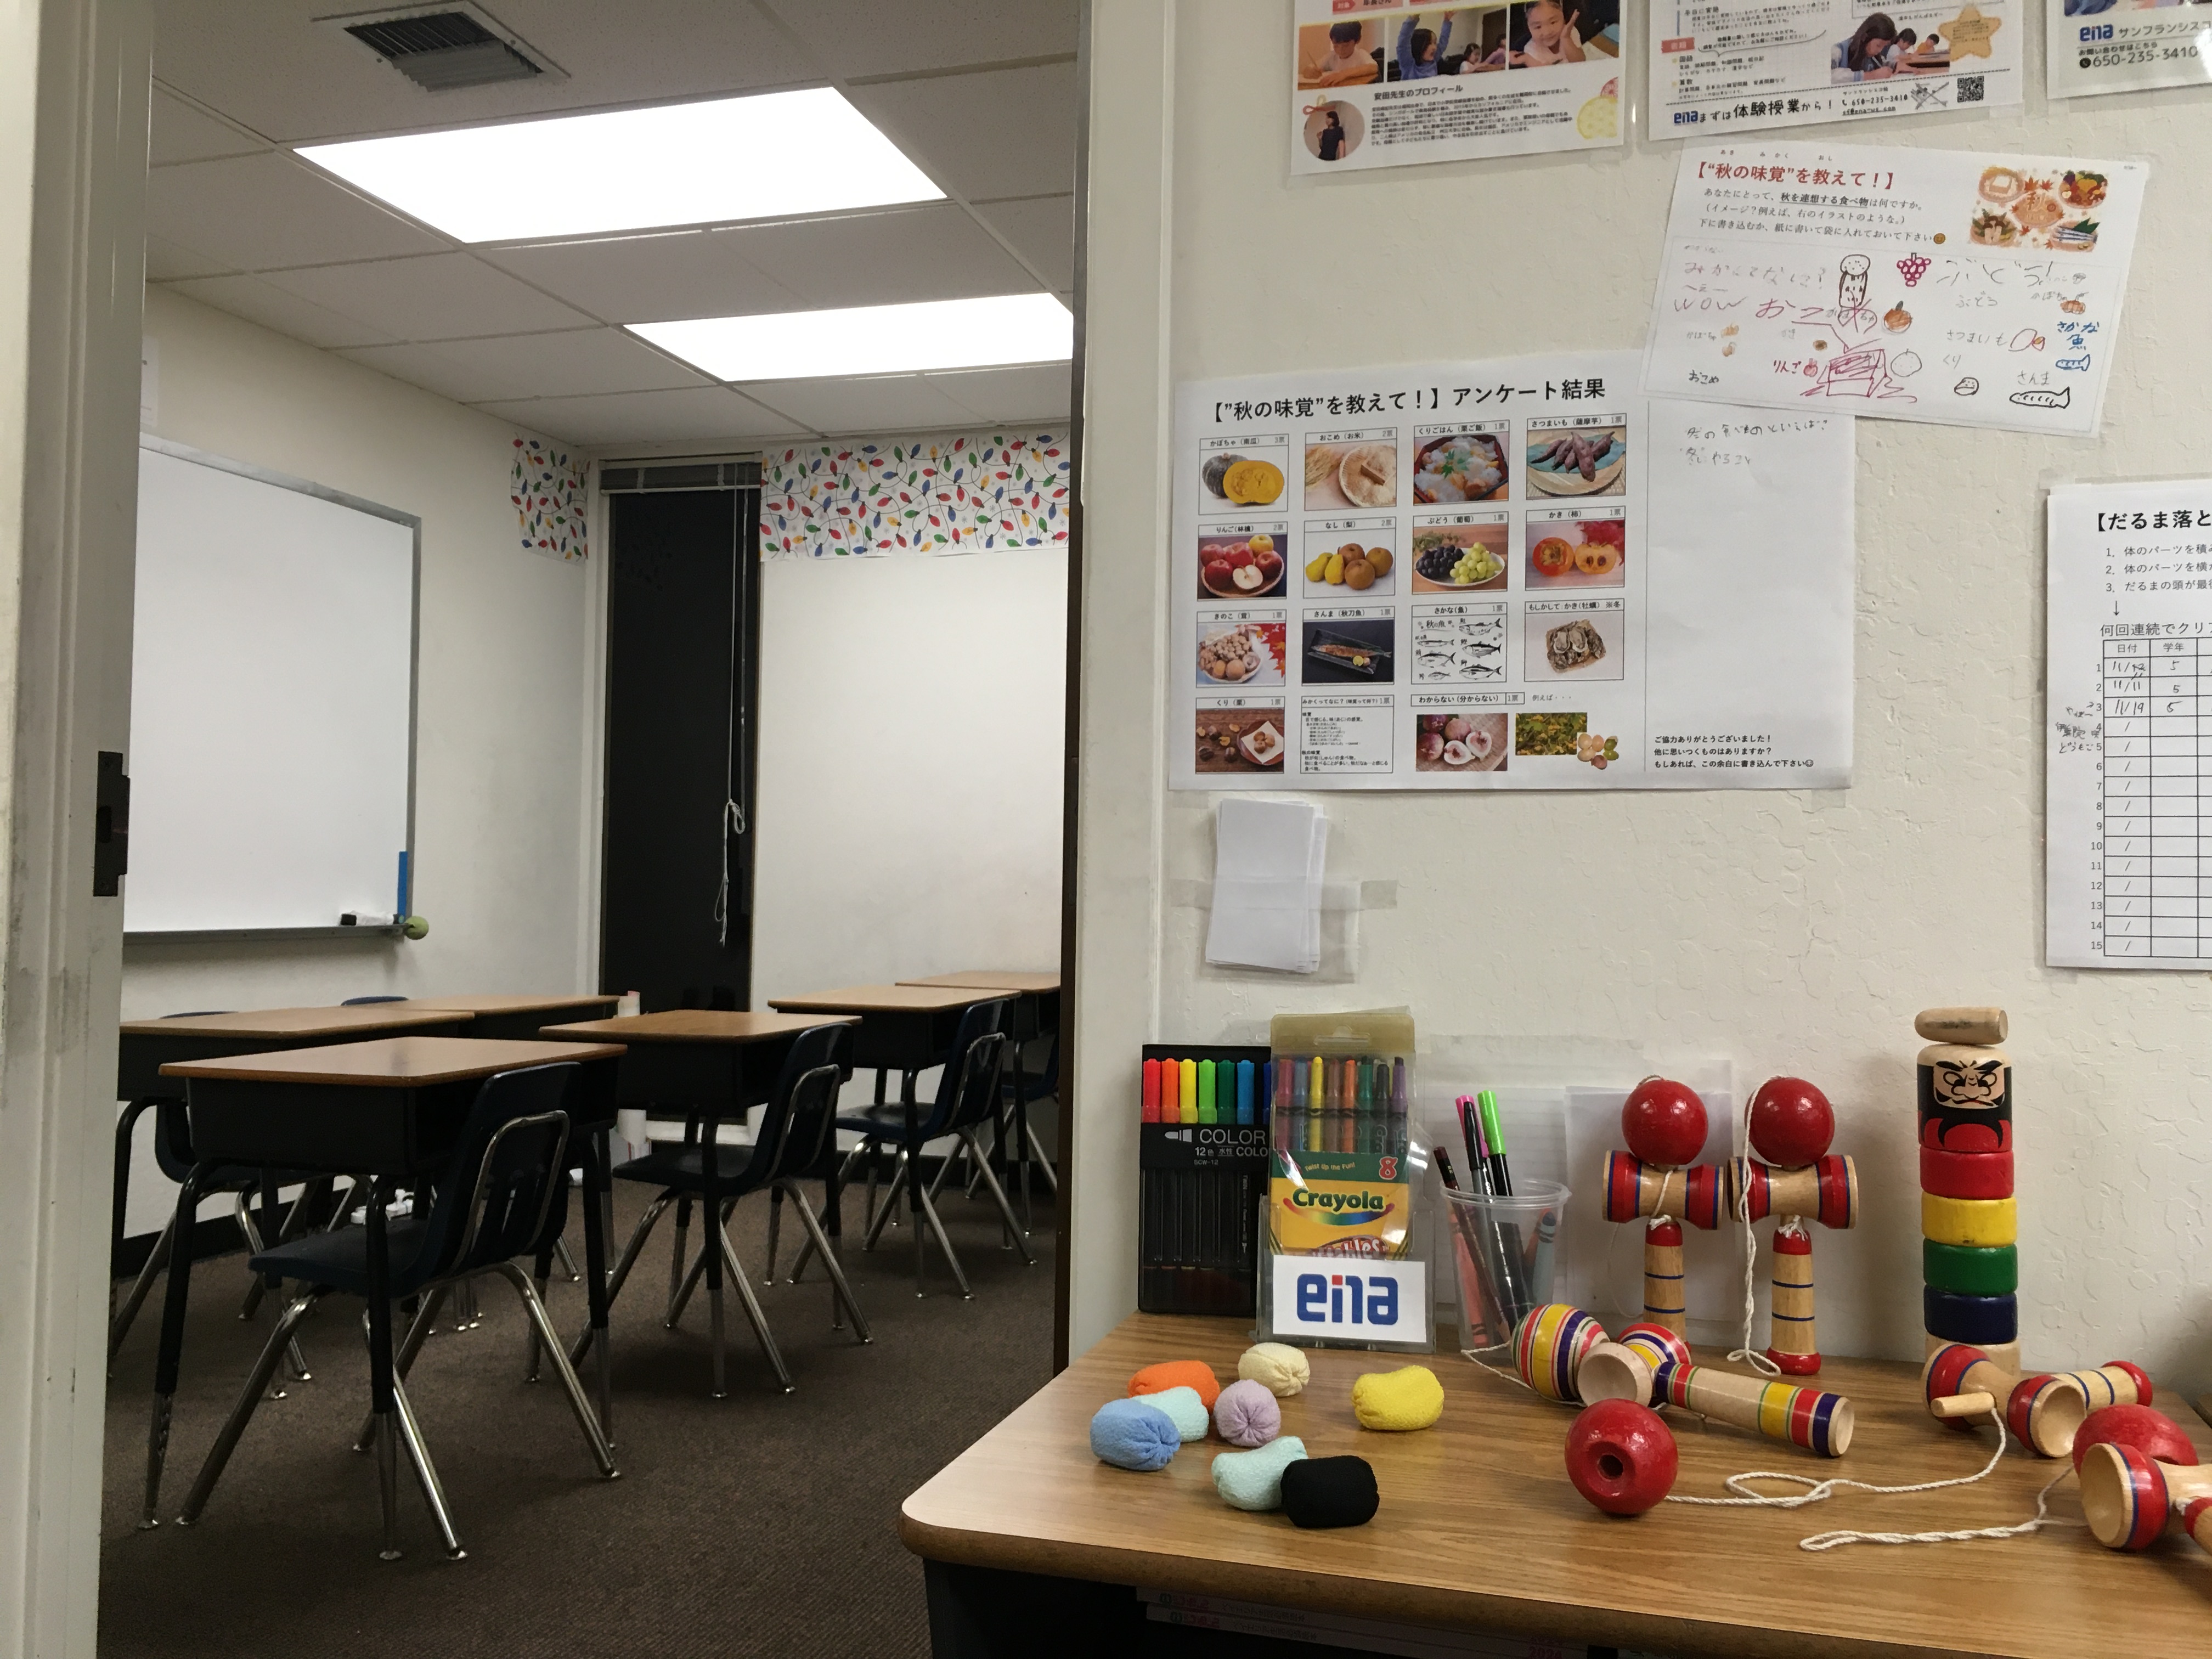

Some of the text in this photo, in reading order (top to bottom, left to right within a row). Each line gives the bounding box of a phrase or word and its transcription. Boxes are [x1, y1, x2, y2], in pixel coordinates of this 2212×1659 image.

[2079, 24, 2113, 41] ena
[2079, 42, 2158, 56] お問い合わせはこちら
[2093, 46, 2199, 67] 650-235-3410
[1374, 84, 1463, 100] 安田先生のプロフィール
[1674, 98, 1832, 125] ena まずは体験授業から！
[1704, 187, 1922, 211] あなたにとって、秋を連想する食べ物は何ですか。
[1955, 290, 1998, 308] ぶどう
[2057, 321, 2100, 333] さかな
[1946, 329, 2008, 347] さつまいも
[1773, 359, 1802, 374] りんご
[1942, 354, 1962, 369] くり
[1688, 369, 1720, 384] おこめ
[2017, 369, 2050, 385] さんま
[2098, 510, 2211, 532] 【だるま落と
[2106, 548, 2115, 557] 1.
[2106, 565, 2115, 575] 2.
[2106, 583, 2115, 593] 3.
[2100, 622, 2212, 637] 何回連続でクリ
[2118, 642, 2184, 653] 日付 学年
[2173, 685, 2181, 693] 5
[2096, 723, 2102, 731] 4
[1655, 735, 1771, 743] ご協力ありがとうございました！
[1654, 747, 1771, 756] 他に思いつくものはありますか？
[1655, 760, 1805, 768] もしあれば、この余白に書き込んで下さい
[2096, 802, 2102, 810] 8
[2091, 882, 2102, 890] 12
[2091, 901, 2102, 910] 13
[2091, 941, 2102, 950] 15
[1199, 1128, 1266, 1145] COLOR
[1305, 1163, 1319, 1172] Twist
[1342, 1161, 1356, 1170] Fun!
[1378, 1155, 1398, 1180] 8
[1292, 1187, 1385, 1212] Crayola
[1296, 1273, 1398, 1325] ena
